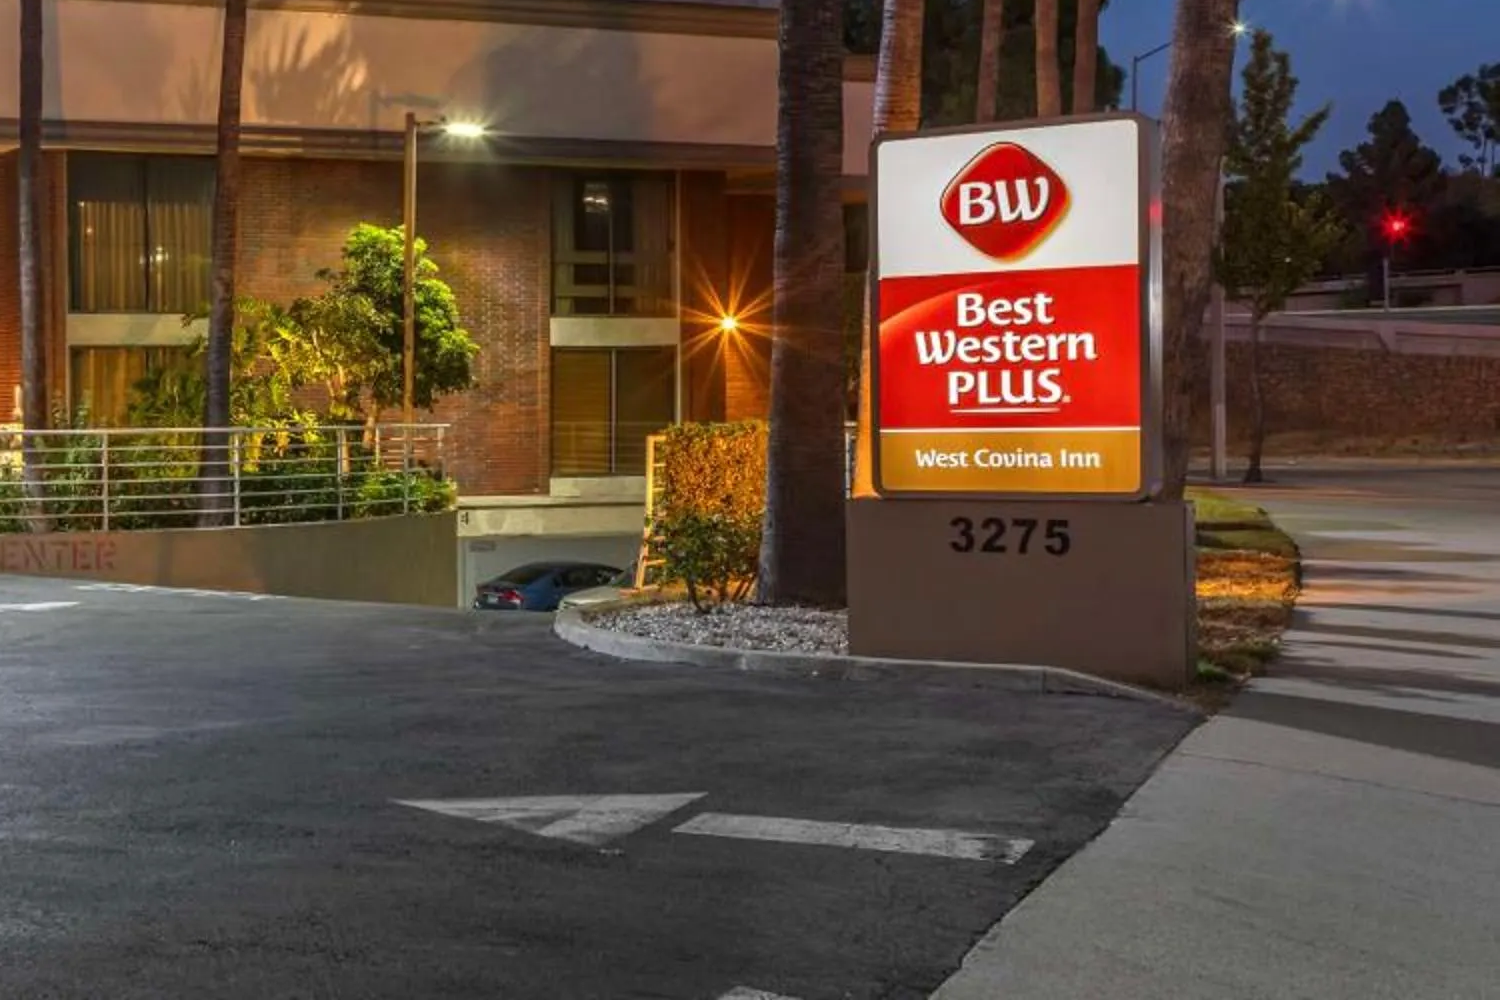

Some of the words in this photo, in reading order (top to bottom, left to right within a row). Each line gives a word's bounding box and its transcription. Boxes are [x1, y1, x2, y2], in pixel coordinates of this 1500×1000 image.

[958, 177, 1049, 226] BW
[956, 293, 1054, 327] Best
[915, 331, 1096, 365] Western
[915, 449, 969, 468] West
[973, 447, 1054, 469] Covina
[1060, 448, 1102, 469] Inn
[949, 516, 1072, 556] 3275
[1, 539, 116, 571] ENTER
